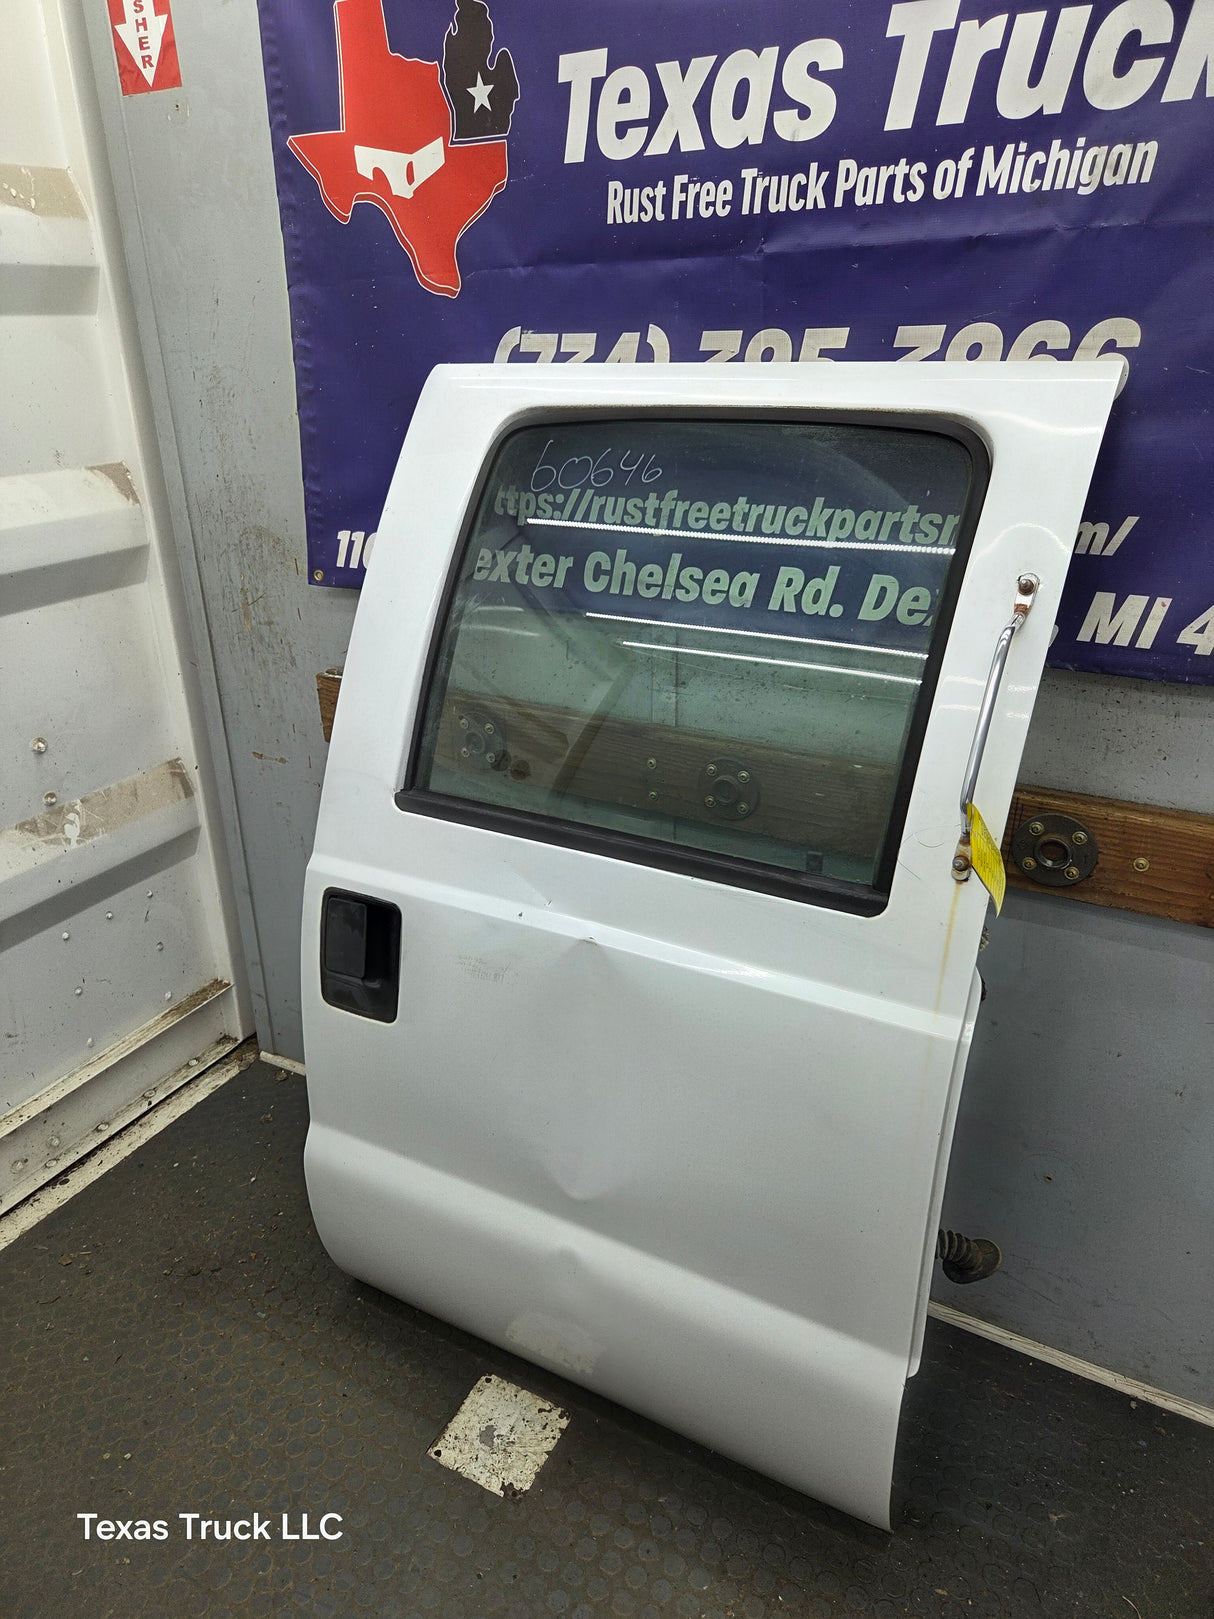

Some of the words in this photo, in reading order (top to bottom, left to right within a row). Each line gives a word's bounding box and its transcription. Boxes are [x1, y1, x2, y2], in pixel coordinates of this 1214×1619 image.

[558, 38, 844, 164] Texas
[606, 180, 667, 225] Rust
[671, 174, 733, 220] Free
[740, 161, 830, 215] Truck
[834, 158, 928, 208] Parts
[932, 147, 976, 200] of
[976, 136, 1159, 196] Michigan
[530, 439, 663, 492] 60646
[583, 549, 760, 608] Chelsea
[767, 565, 844, 618] Rd.
[857, 573, 940, 628] De
[1076, 591, 1173, 650] MI
